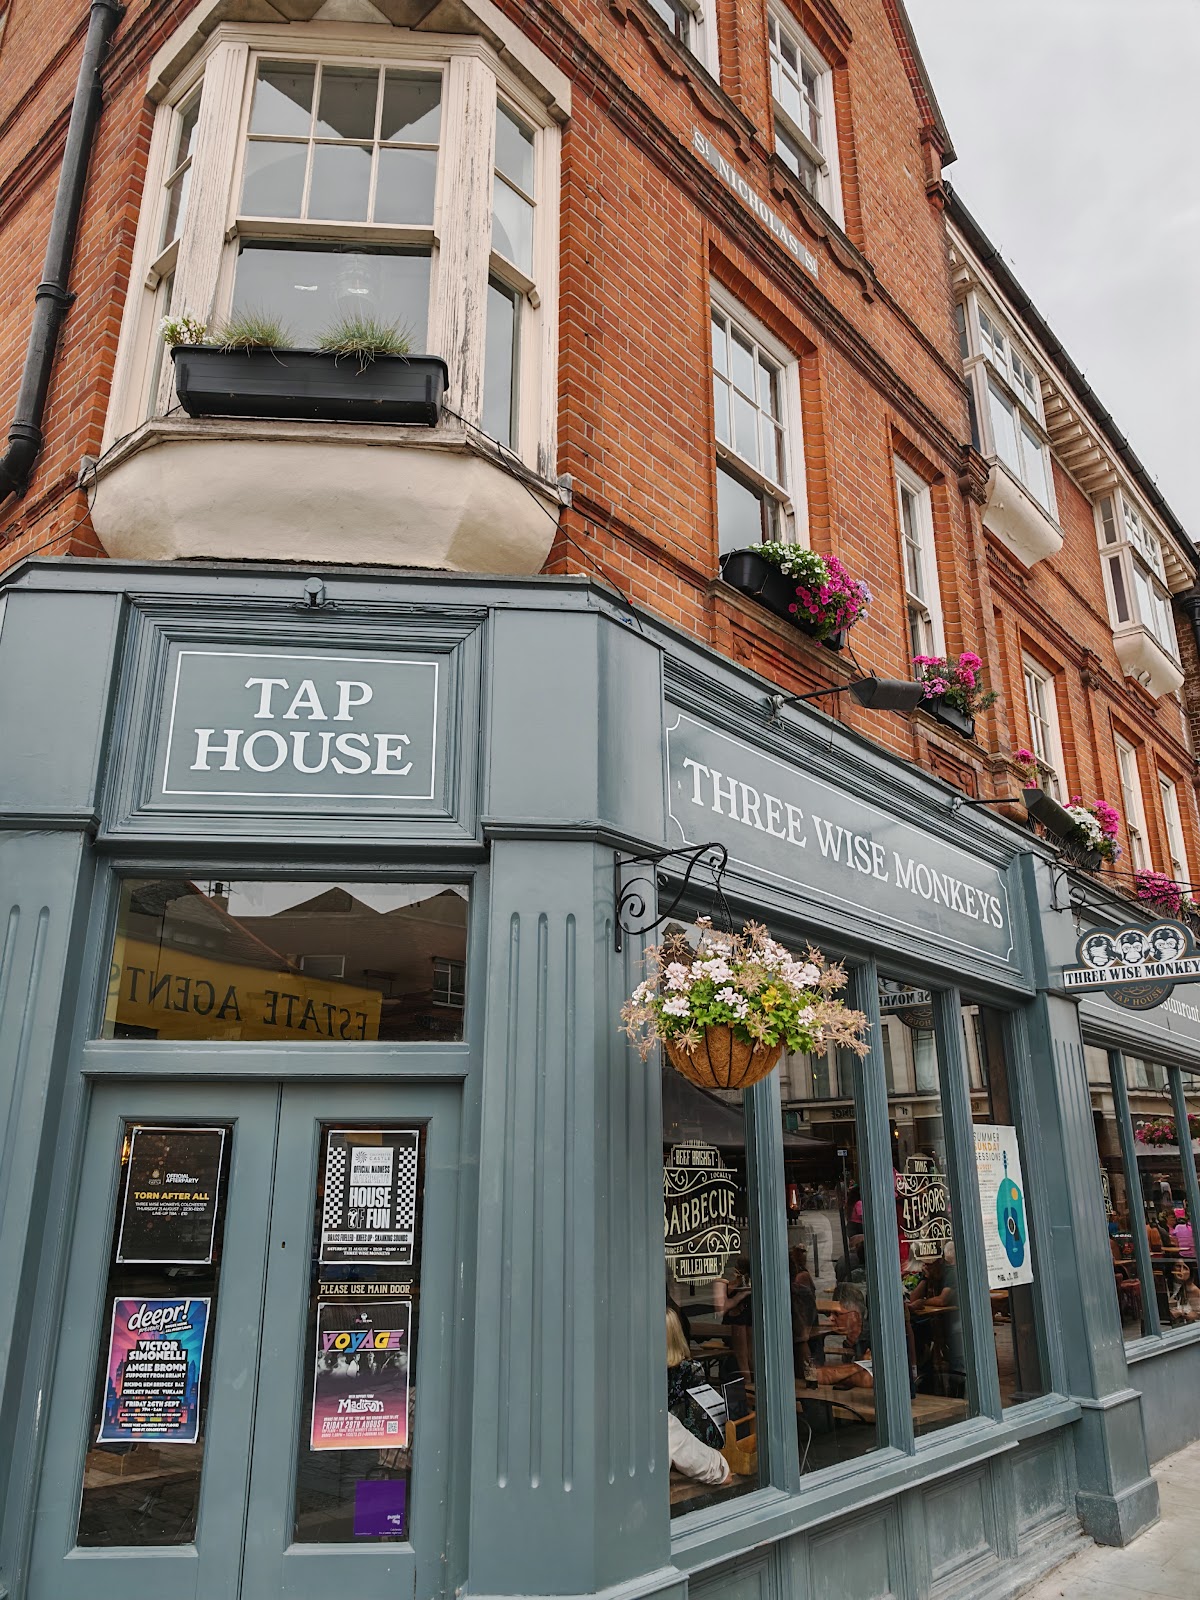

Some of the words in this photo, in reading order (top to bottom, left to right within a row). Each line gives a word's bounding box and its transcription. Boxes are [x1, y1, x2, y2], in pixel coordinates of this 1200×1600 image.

[718, 156, 799, 255] NICHOLAS
[244, 677, 374, 721] TAP
[189, 728, 414, 776] HOUSE
[683, 757, 807, 848] THREE
[811, 814, 889, 883] WISE
[892, 852, 1004, 930] MONKEYS
[1065, 969, 1107, 985] THREE
[1109, 966, 1142, 980] WISE
[1144, 960, 1200, 976] MONKEY
[1113, 990, 1131, 1003] TAP
[1133, 986, 1164, 1006] HOUSE
[973, 1132, 1000, 1142] SUMMER
[675, 1149, 691, 1166] BEEF
[691, 1150, 716, 1167] BRISKET
[914, 1160, 928, 1173] DINE
[710, 1171, 732, 1180] LOCALLY
[134, 1192, 160, 1200] TORN
[161, 1192, 191, 1200] AFTER
[192, 1192, 210, 1201] ALL
[348, 1186, 392, 1208] HOUSE
[902, 1198, 911, 1229] 4
[911, 1187, 946, 1229] FLOORS
[347, 1207, 366, 1229] OF
[366, 1208, 391, 1229] FUN
[664, 1245, 684, 1254] URCED
[919, 1241, 938, 1256] DANCE
[680, 1259, 703, 1276] PULLED
[703, 1257, 718, 1275] PORK
[320, 1284, 349, 1295] PLEASE
[350, 1284, 366, 1294] USE
[367, 1284, 388, 1294] MAIN
[390, 1284, 411, 1294] DOOR
[127, 1300, 191, 1332] deepr!
[138, 1340, 179, 1351] VICTOR
[321, 1327, 405, 1354] VOYAGE
[128, 1350, 187, 1361] SIMONELLI
[126, 1363, 154, 1372] ANGIE
[154, 1363, 187, 1372] BROWN
[125, 1400, 147, 1408] FRIDAY
[147, 1400, 164, 1408] 26TH
[164, 1400, 181, 1408] SEPT
[337, 1399, 384, 1413] Madison
[322, 1421, 345, 1430] FRIDAY
[361, 1419, 385, 1429] AUGUST
